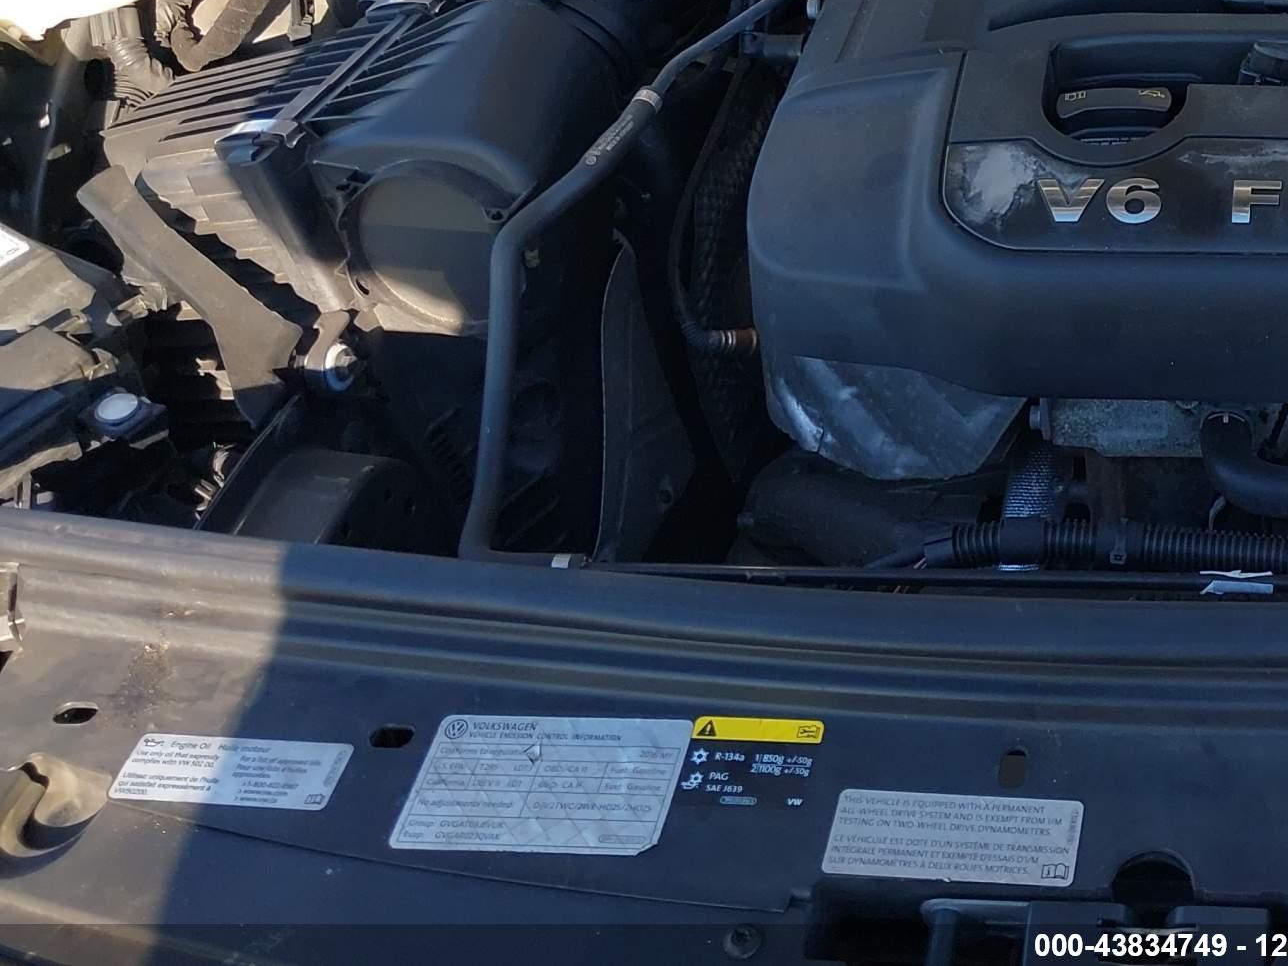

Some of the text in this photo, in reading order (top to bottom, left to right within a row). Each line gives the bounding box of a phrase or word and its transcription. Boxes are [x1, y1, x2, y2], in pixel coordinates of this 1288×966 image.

[1037, 177, 1162, 224] V6
[472, 721, 538, 731] VOLKSWAGEN
[715, 752, 745, 761] R-134a
[709, 772, 729, 781] PAG
[705, 784, 743, 793] SAE J639
[787, 798, 804, 806] VW
[866, 797, 900, 806] VEHICLE
[959, 802, 981, 811] WITH
[993, 804, 1045, 814] PERMANENT
[920, 810, 951, 819] SYSTEM
[953, 812, 973, 821] AND
[985, 814, 1018, 823] EXEMPT
[1021, 816, 1045, 824] FROM
[839, 817, 874, 827] TESTING
[876, 819, 890, 827] ON
[949, 823, 975, 832] DRIVE
[878, 848, 928, 858] PERMANENT
[993, 842, 1005, 851] DE
[1007, 843, 1070, 854] TRANSMISSION
